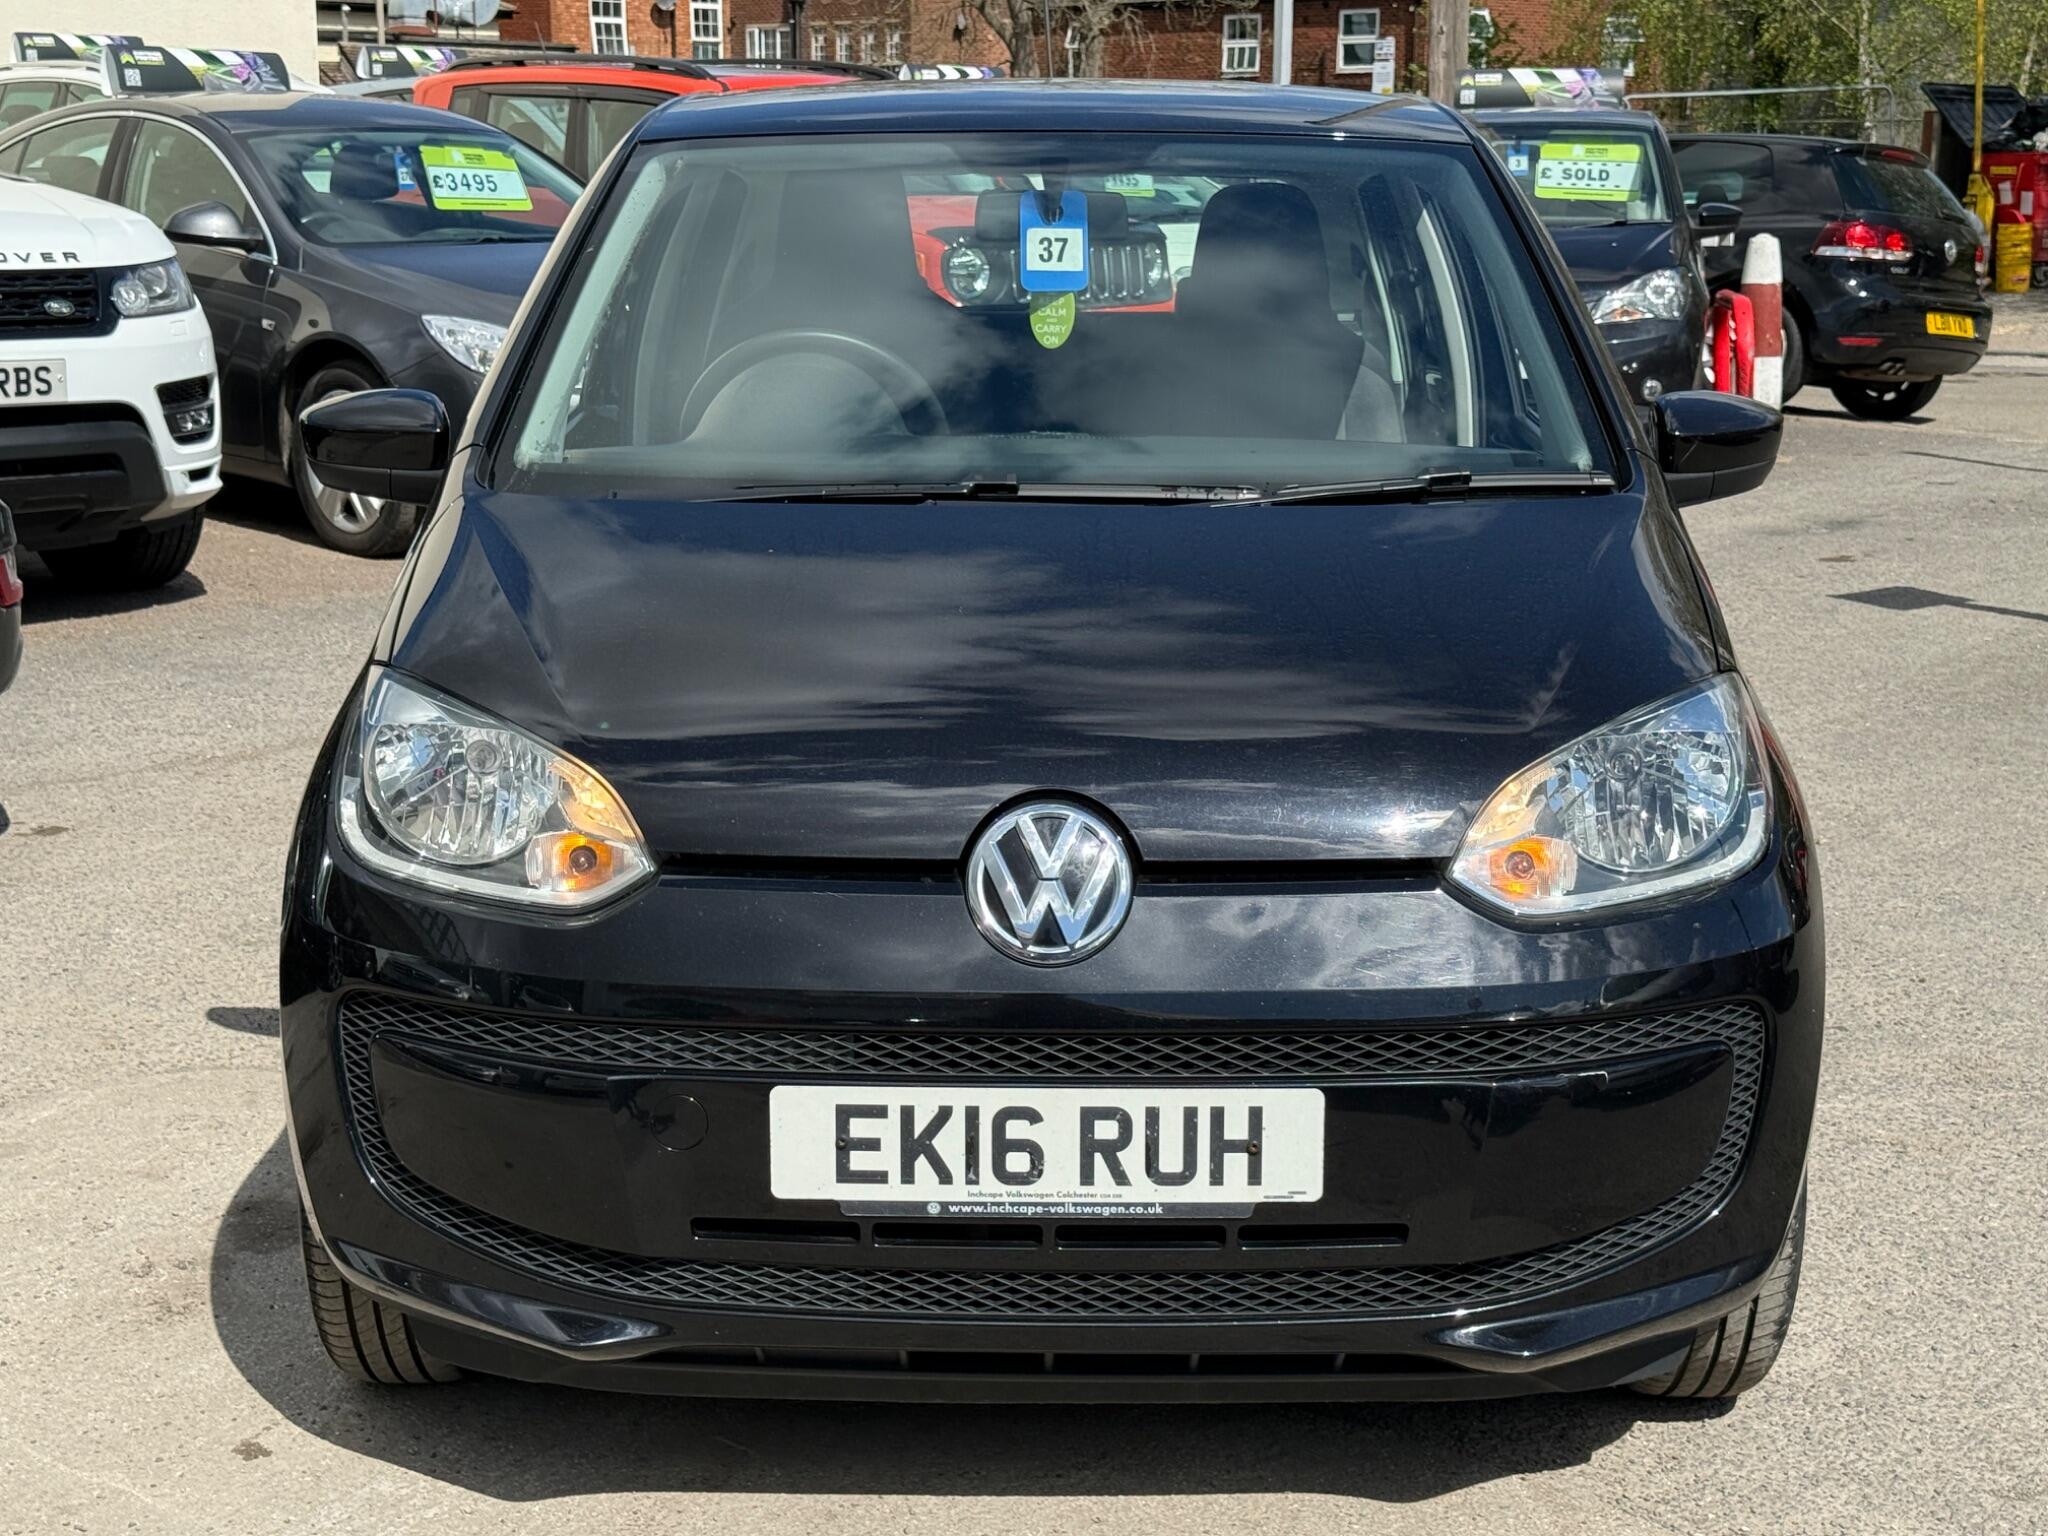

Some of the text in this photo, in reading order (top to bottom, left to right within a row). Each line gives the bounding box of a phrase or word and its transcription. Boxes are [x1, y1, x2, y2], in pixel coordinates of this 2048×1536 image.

[1562, 167, 1610, 182] SOLD
[432, 172, 498, 193] £3495
[1038, 237, 1069, 263] 37
[1035, 324, 1067, 334] CARRY
[1043, 335, 1059, 345] ON
[835, 1104, 1264, 1187] EK16 RUH
[967, 1190, 1003, 1199] Inchcape
[1006, 1190, 1055, 1199] Volkswagen
[1056, 1190, 1098, 1199] Colchester
[948, 1203, 1164, 1215] www.inchcape-volkswagen.co.uk
